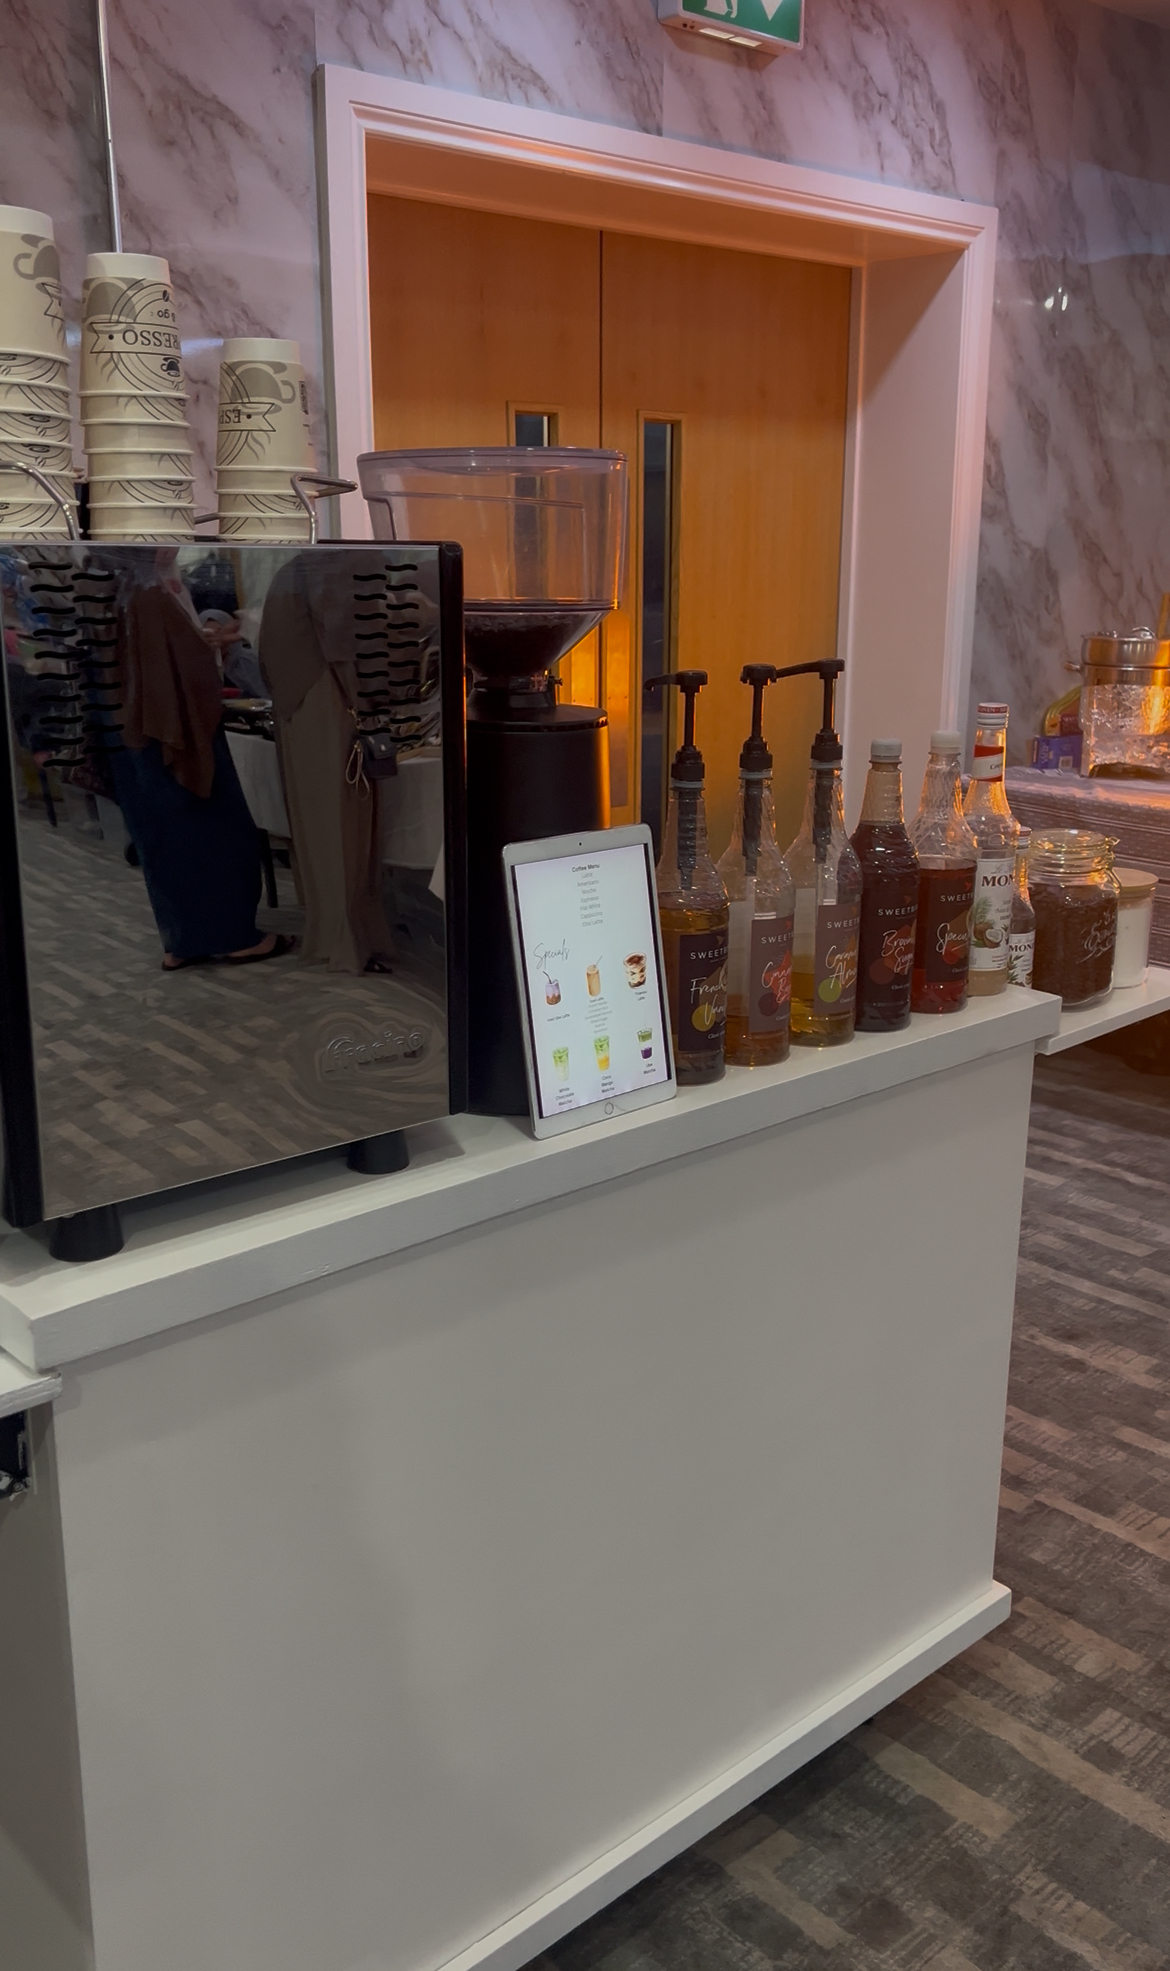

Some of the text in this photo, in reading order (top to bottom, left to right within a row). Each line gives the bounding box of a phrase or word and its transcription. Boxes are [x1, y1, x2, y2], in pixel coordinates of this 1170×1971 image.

[588, 864, 600, 872] Menu
[578, 880, 600, 888] Americano
[534, 938, 570, 970] Specials
